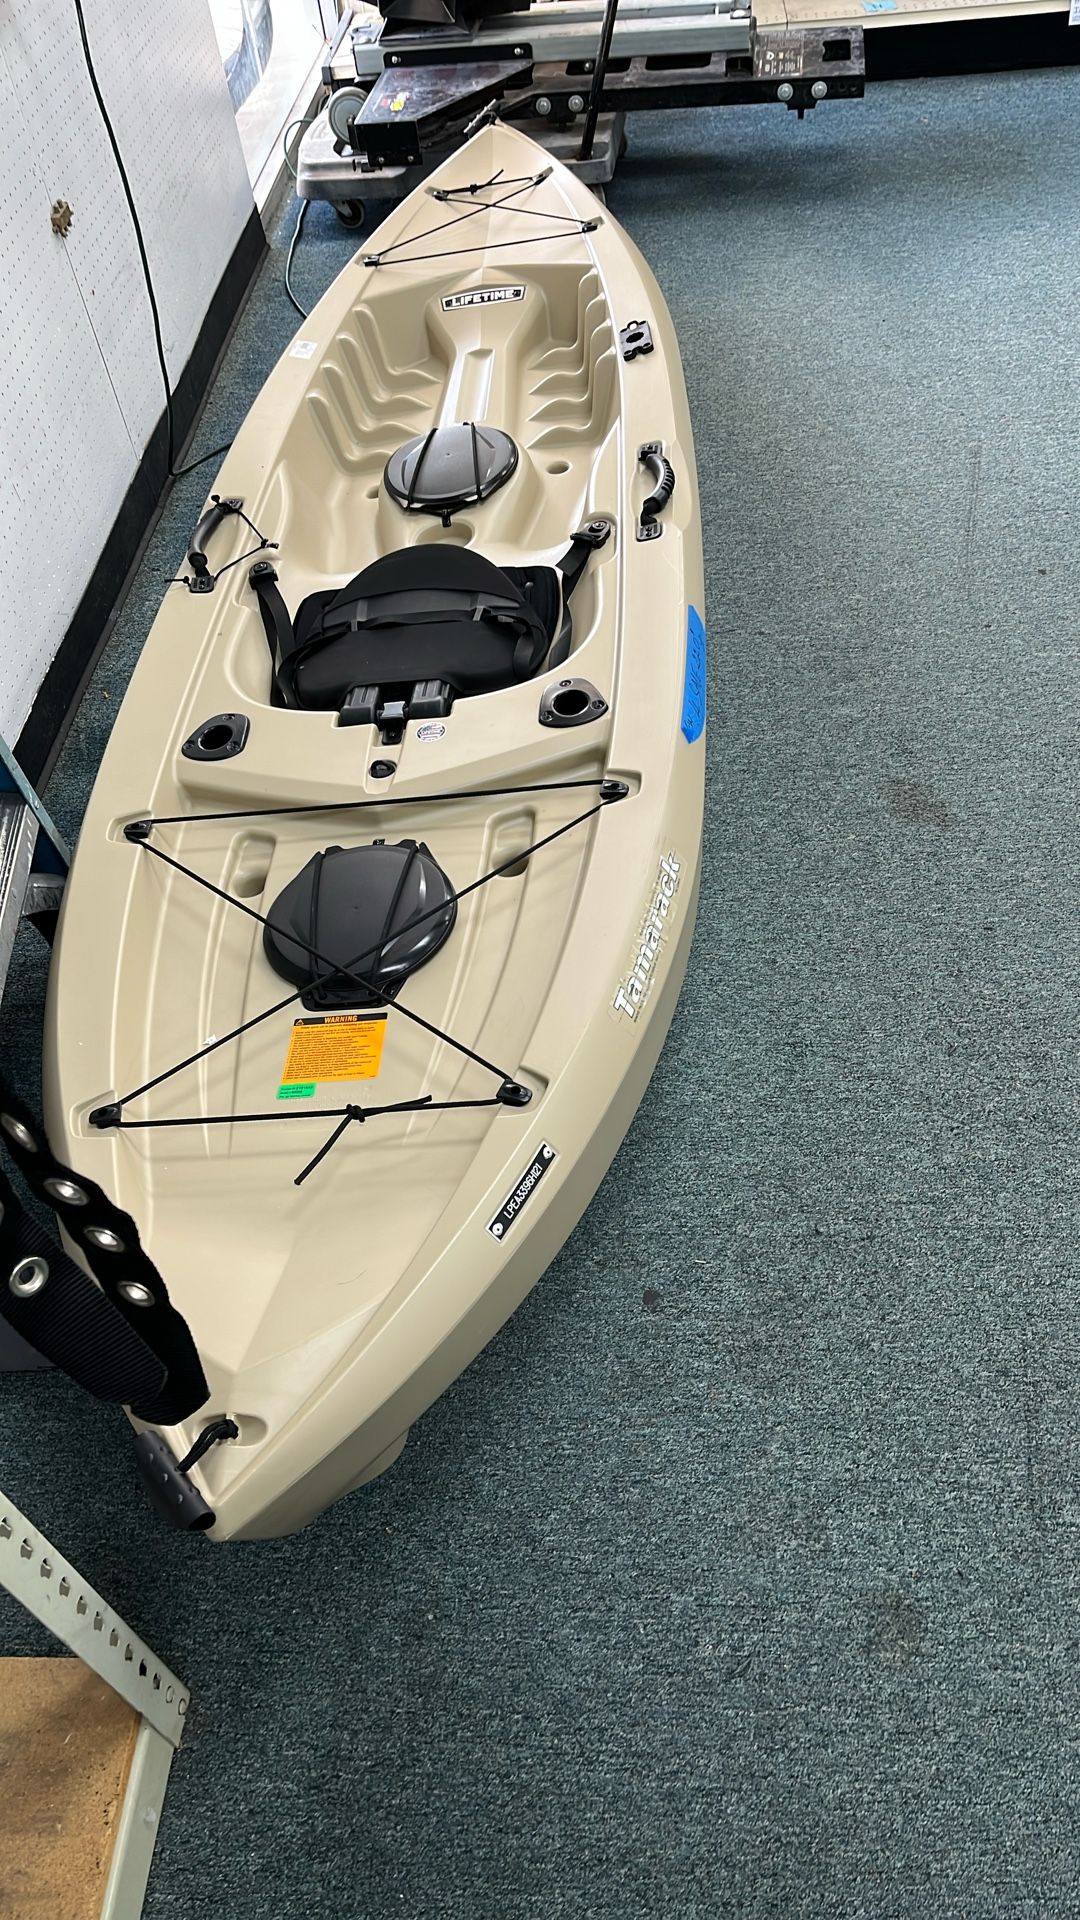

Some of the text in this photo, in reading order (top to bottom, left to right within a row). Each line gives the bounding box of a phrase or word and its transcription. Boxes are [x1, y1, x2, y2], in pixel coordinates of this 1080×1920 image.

[451, 289, 514, 306] LIFETIME
[613, 852, 681, 1018] Tamarack
[324, 1015, 358, 1024] WARNING
